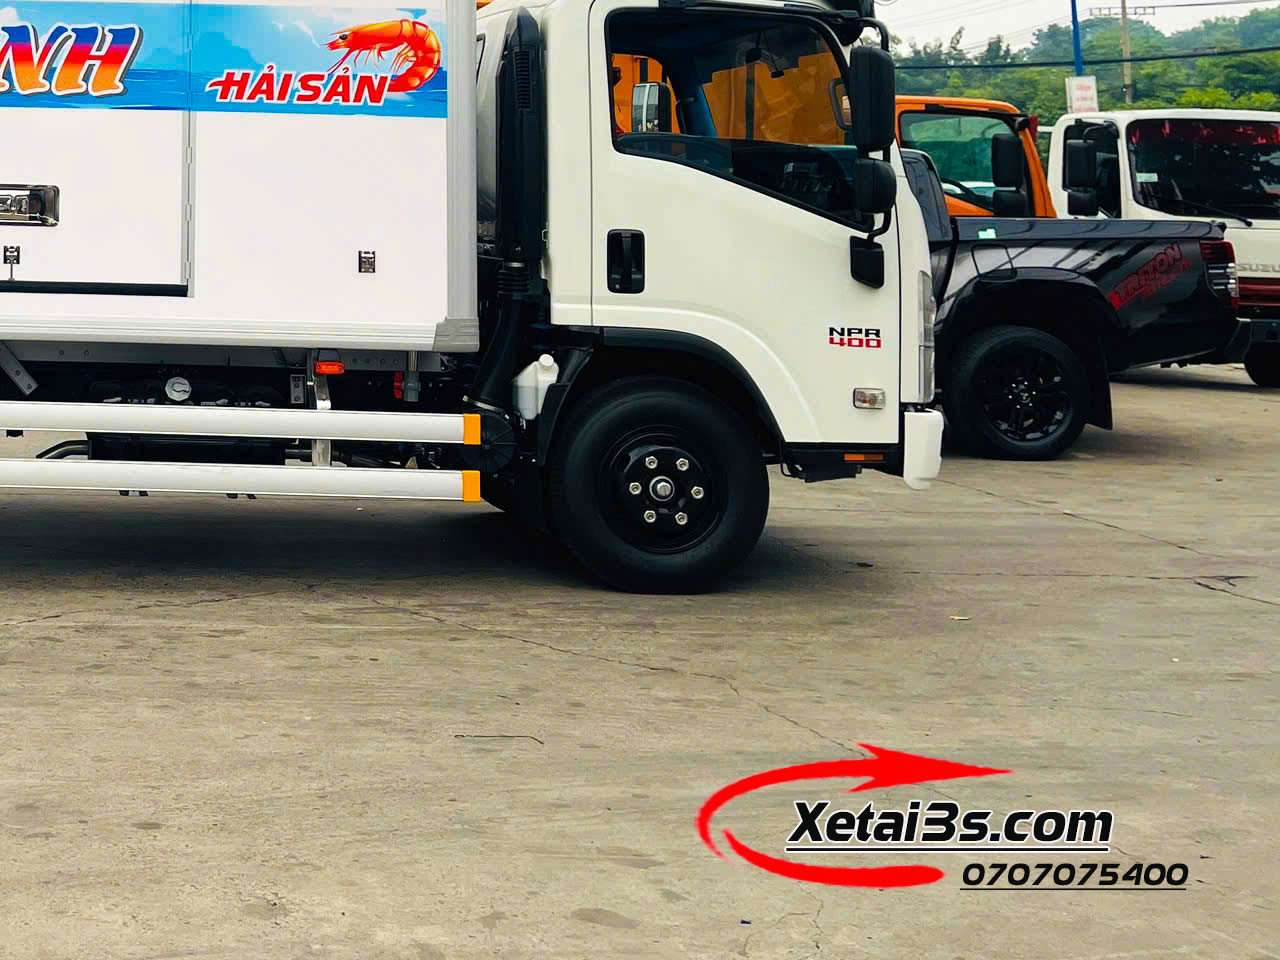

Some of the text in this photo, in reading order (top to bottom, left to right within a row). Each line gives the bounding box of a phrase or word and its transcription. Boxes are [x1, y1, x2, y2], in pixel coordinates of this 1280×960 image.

[206, 63, 389, 104] HẢI SẢN
[828, 326, 881, 338] NPR
[828, 337, 882, 348] 400
